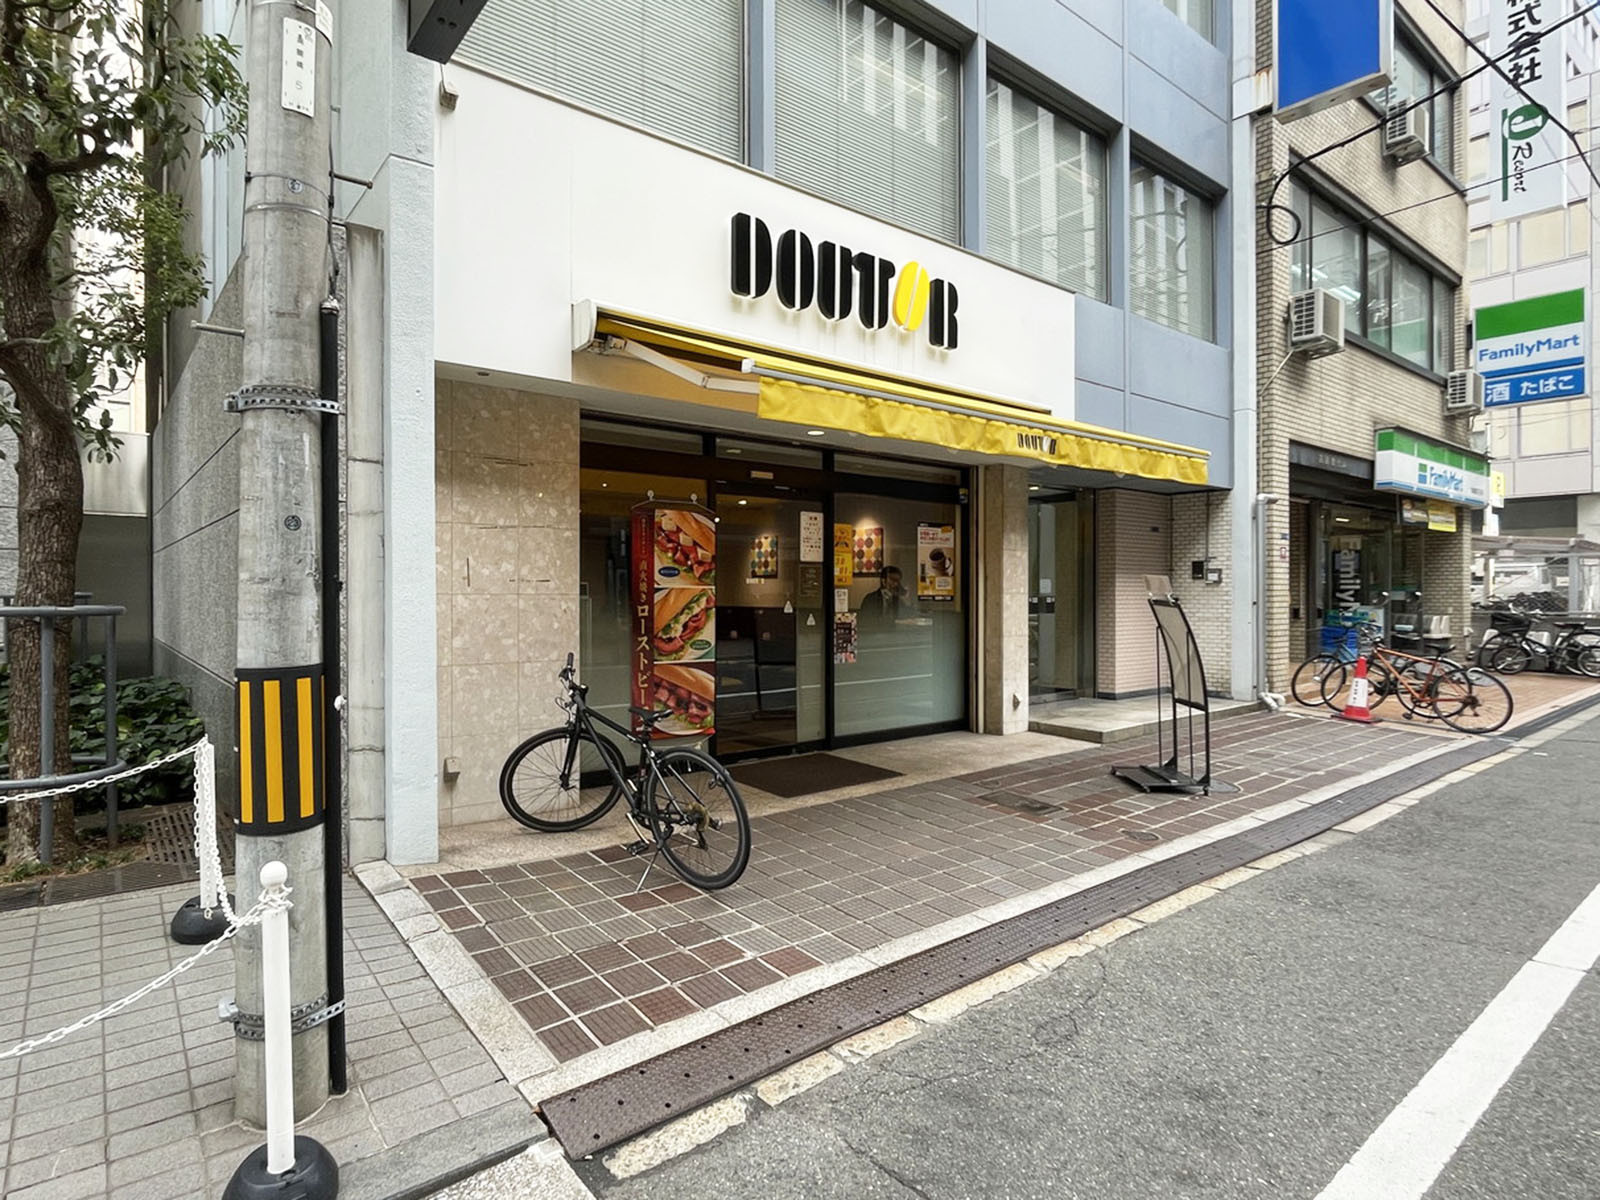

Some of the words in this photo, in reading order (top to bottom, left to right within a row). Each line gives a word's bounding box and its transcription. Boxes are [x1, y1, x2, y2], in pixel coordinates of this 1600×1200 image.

[1507, 0, 1542, 87] 式会社
[731, 212, 958, 350] DOUTOR
[1479, 334, 1580, 362] FamilyMart
[1486, 382, 1511, 403] 酒
[1520, 375, 1575, 396] たばこ
[1017, 432, 1057, 455] DOUTOR
[636, 604, 650, 722] ローストビー
